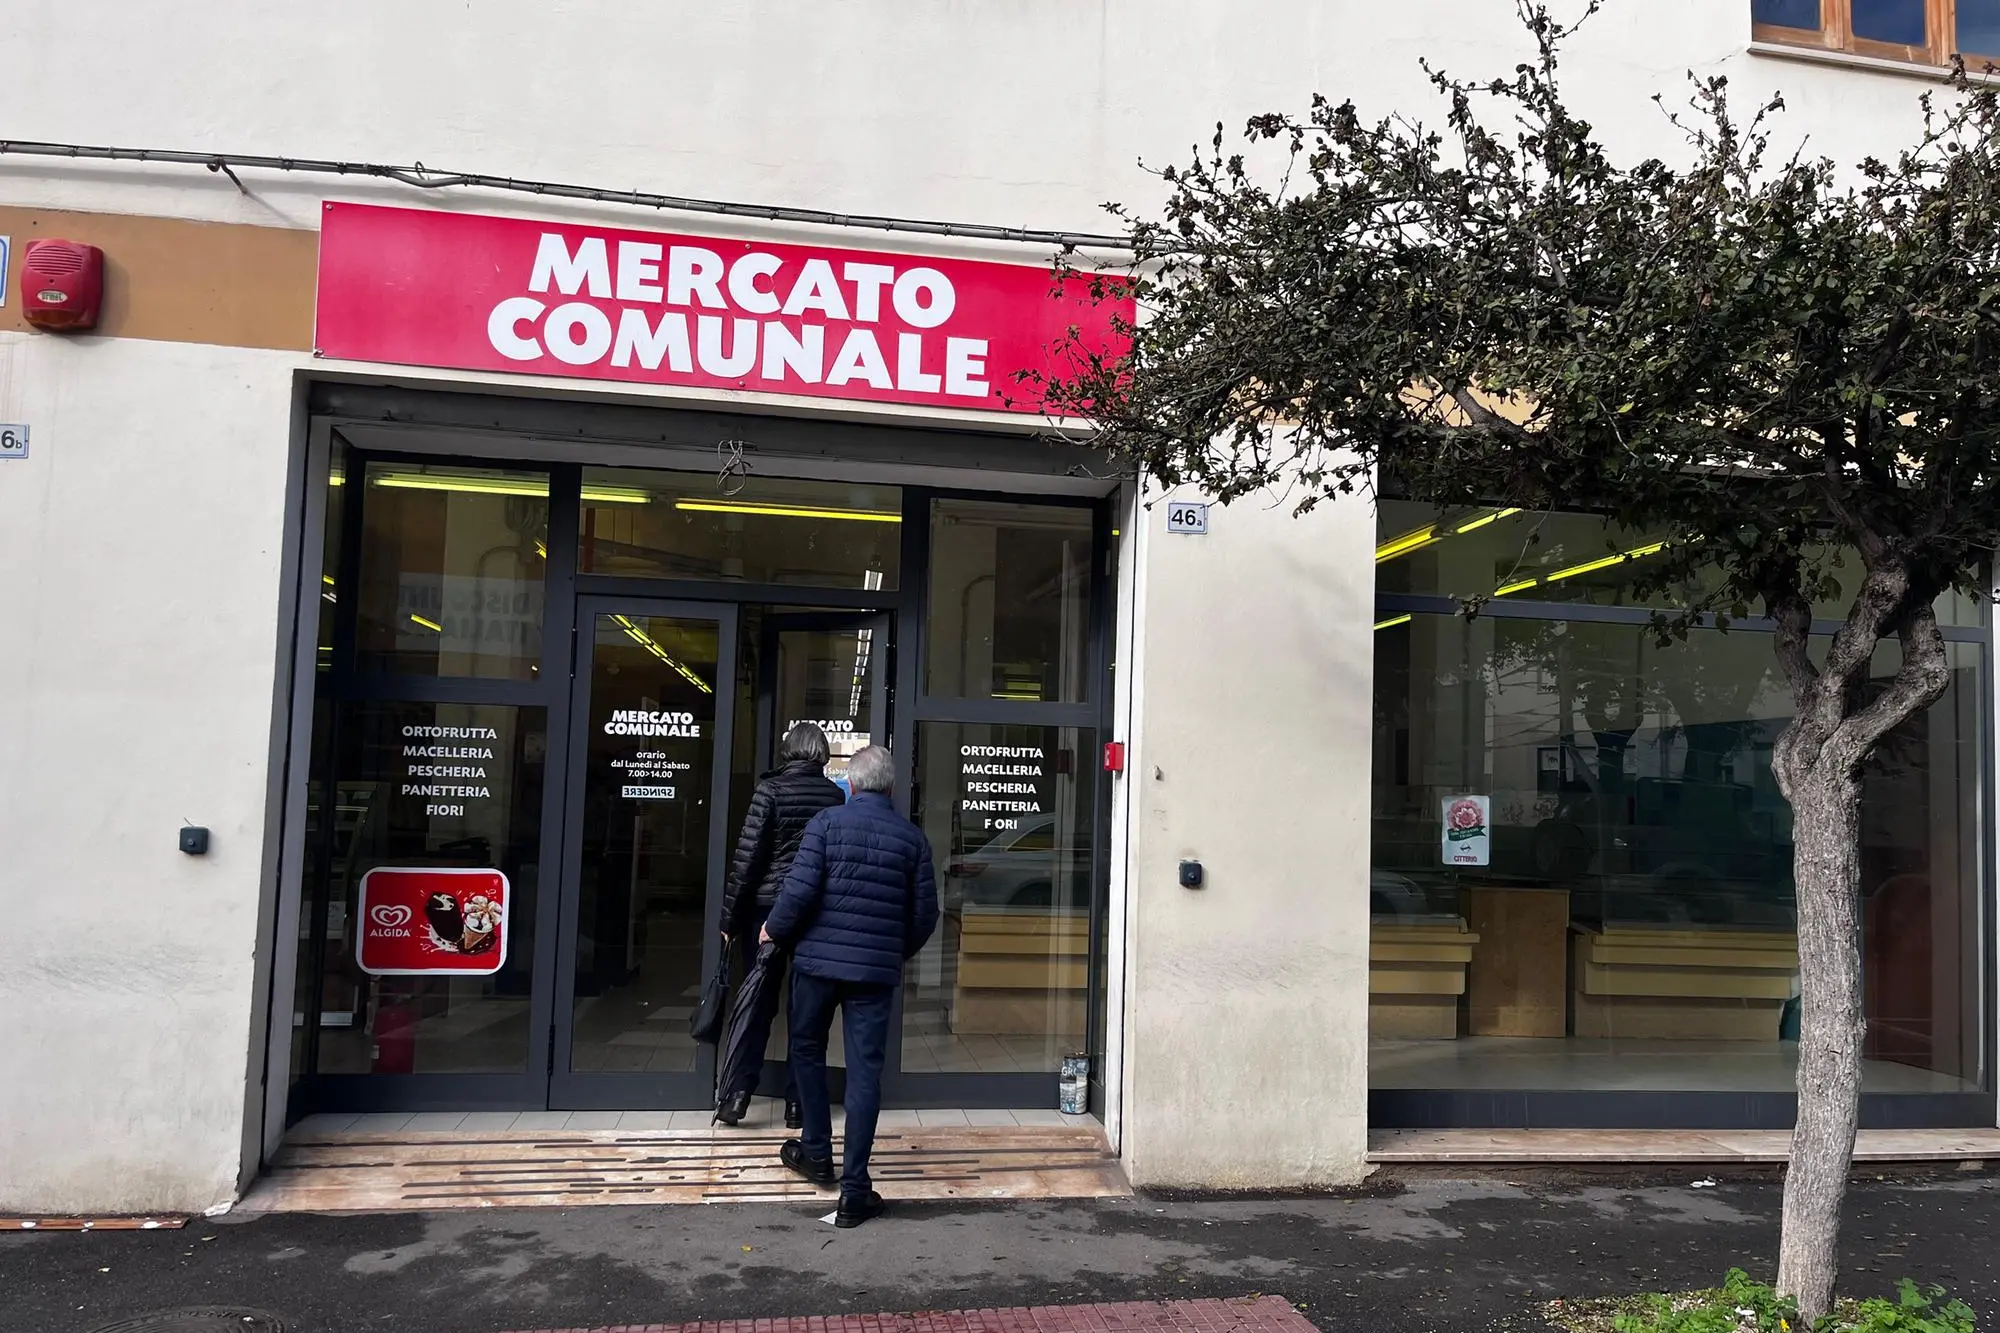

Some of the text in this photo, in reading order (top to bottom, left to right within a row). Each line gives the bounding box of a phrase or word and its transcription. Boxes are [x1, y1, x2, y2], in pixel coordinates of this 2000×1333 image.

[528, 232, 956, 329] MERCATO
[487, 296, 990, 398] COMUNALE
[612, 709, 694, 725] MERCATO
[402, 725, 498, 740] ORTOFRUTTA
[604, 722, 700, 738] COMUNALE
[402, 745, 494, 760] MACELLERIA
[636, 750, 666, 759] orario
[960, 745, 1044, 759] ORTOFRUTTA
[408, 765, 487, 779] PESCHERIA
[610, 760, 625, 768] dal
[662, 761, 690, 770] Sabato
[962, 763, 1043, 777] MACELLERIA
[401, 784, 491, 798] PANETTERIA
[967, 782, 1038, 795] PESCHERIA
[426, 804, 464, 817] FIORI
[962, 800, 1042, 813] PANETTERIA
[984, 818, 1018, 831] FORI
[369, 928, 412, 938] ALGIDA
